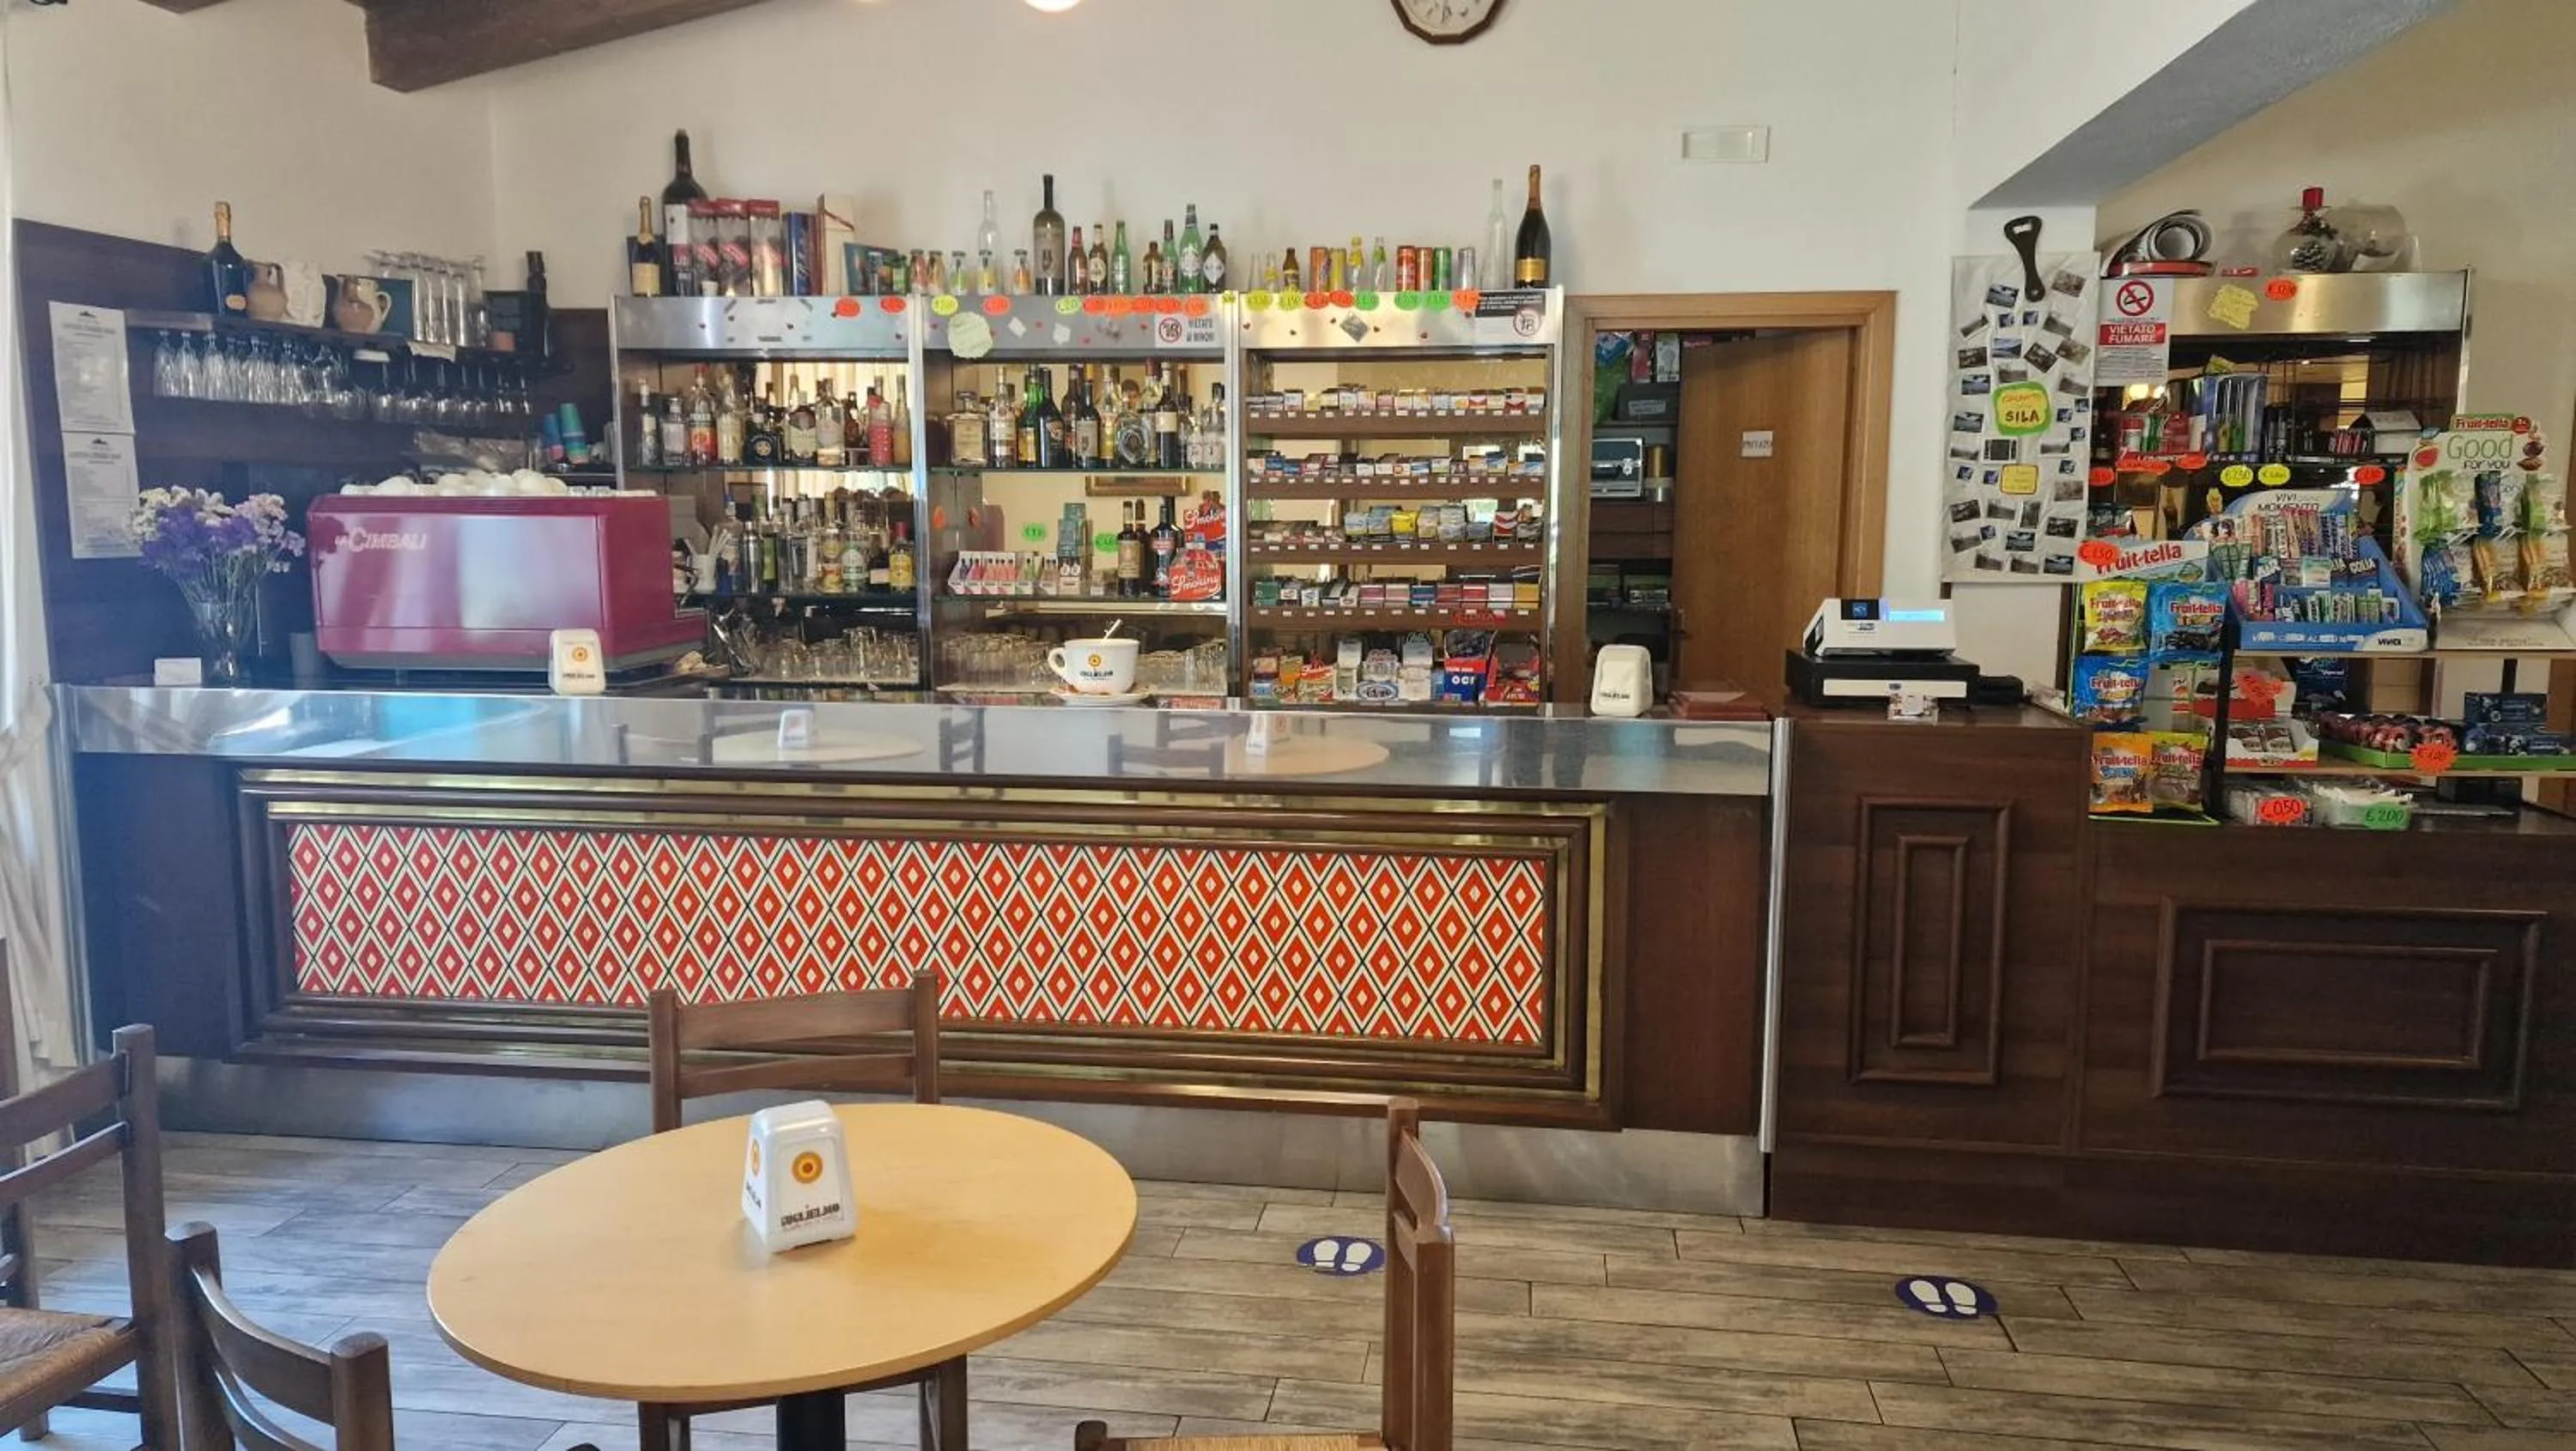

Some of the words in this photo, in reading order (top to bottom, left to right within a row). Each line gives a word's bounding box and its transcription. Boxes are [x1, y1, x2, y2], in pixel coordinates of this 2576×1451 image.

[2109, 325, 2156, 334] VIETATO
[2108, 333, 2156, 344] FUMARE
[2005, 410, 2040, 423] SILA
[2446, 433, 2513, 458] Good
[349, 526, 428, 553] CIMBALI
